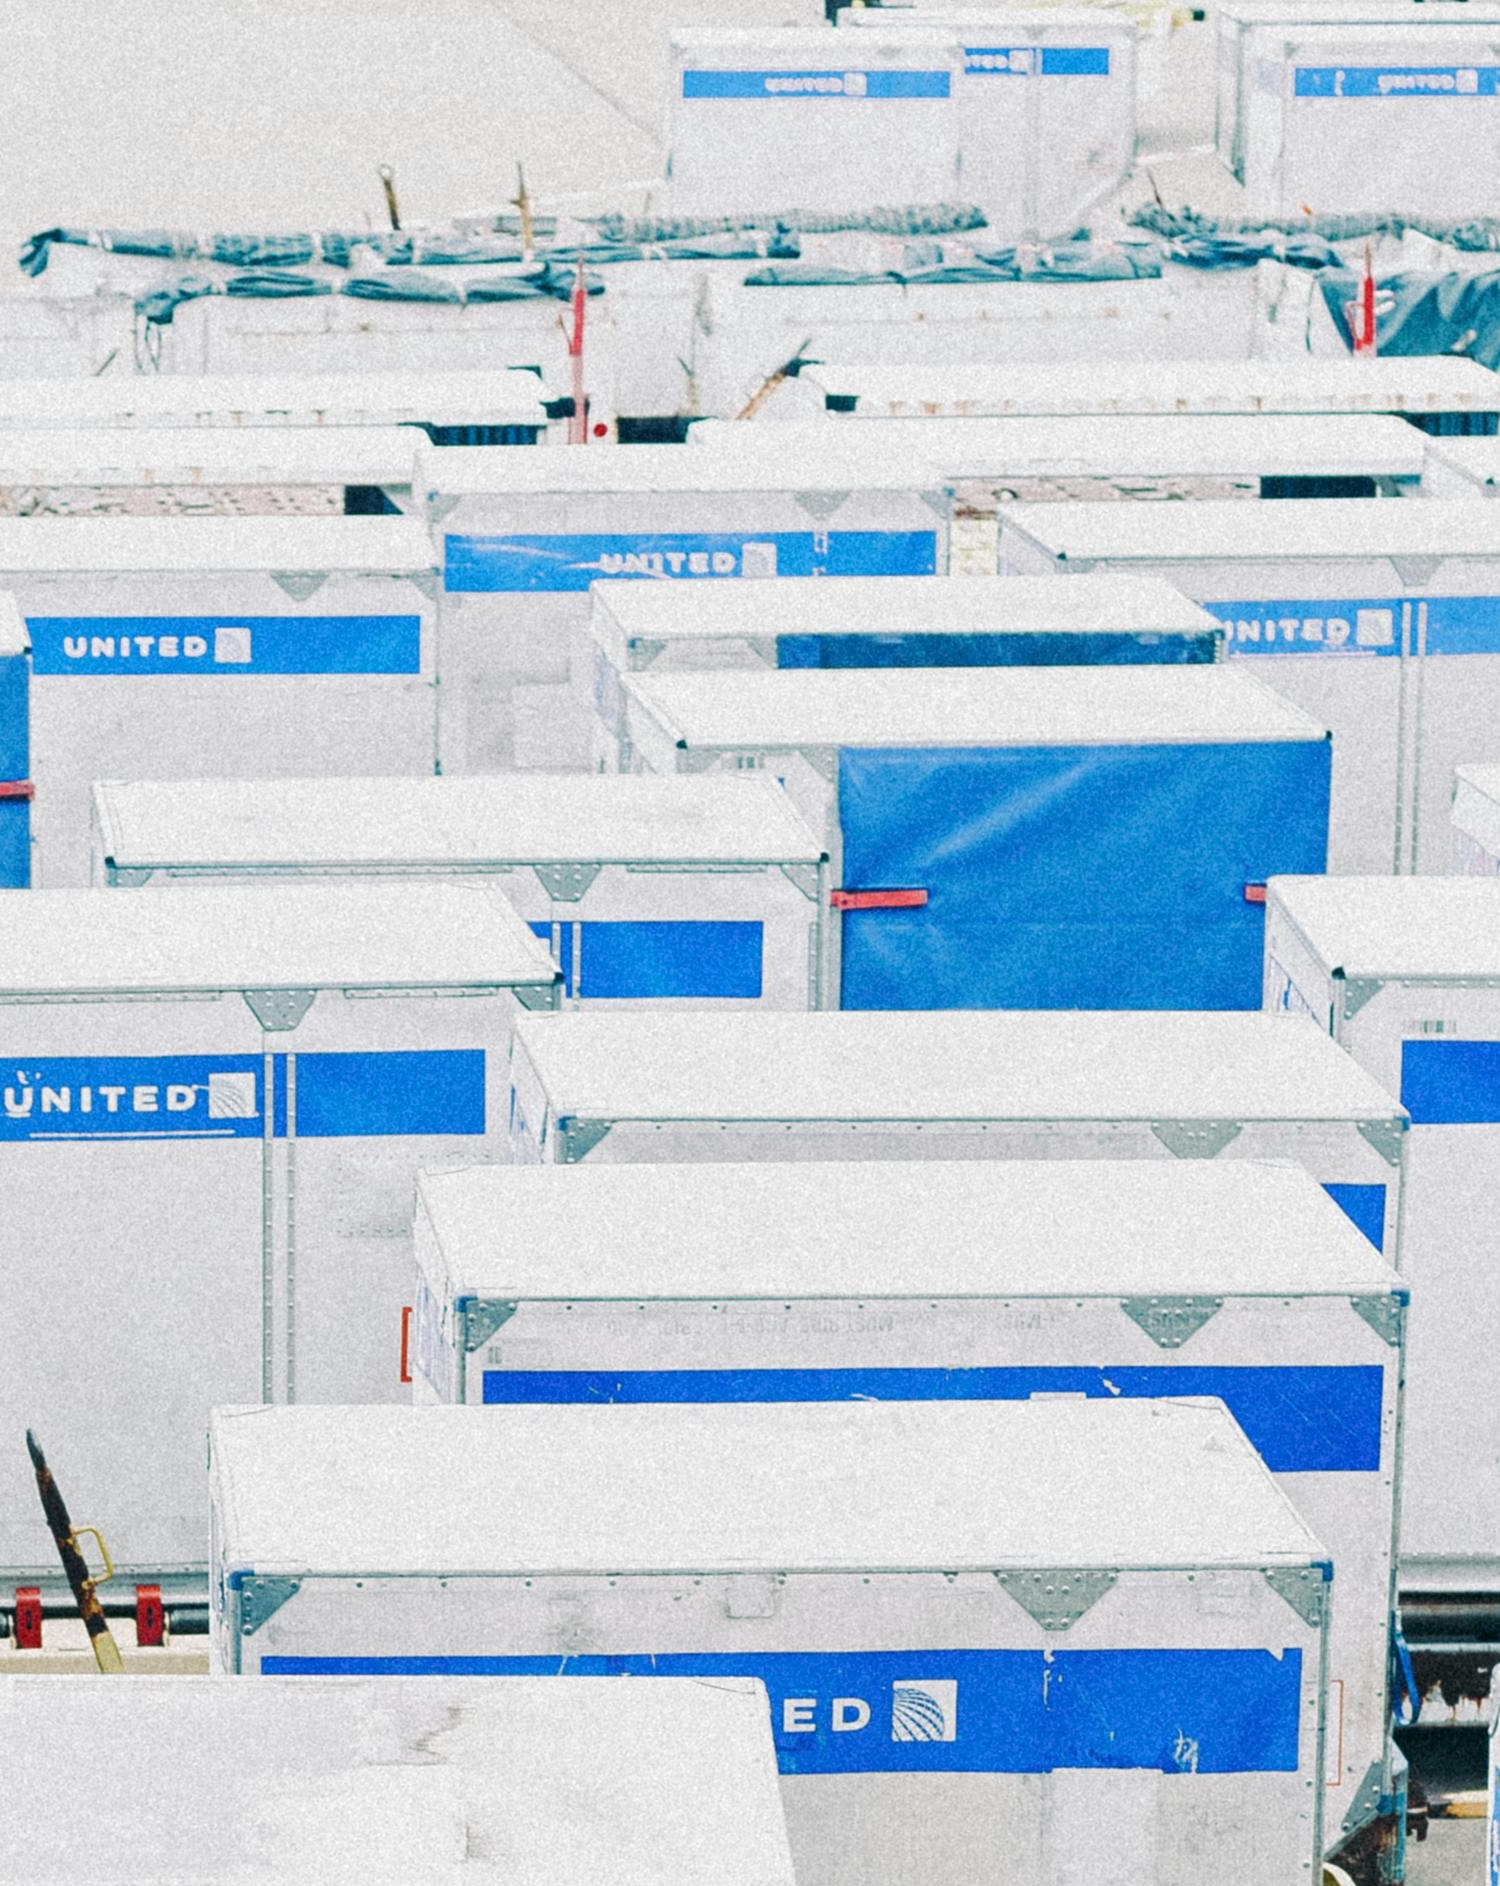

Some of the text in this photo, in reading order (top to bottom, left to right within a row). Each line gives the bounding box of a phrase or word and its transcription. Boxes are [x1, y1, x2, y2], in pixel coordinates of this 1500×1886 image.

[764, 77, 843, 93] UNITED
[1378, 74, 1455, 92] UNITED
[600, 552, 736, 574] UNITED
[63, 637, 207, 659] UNITED
[6, 1084, 197, 1114] UNITED
